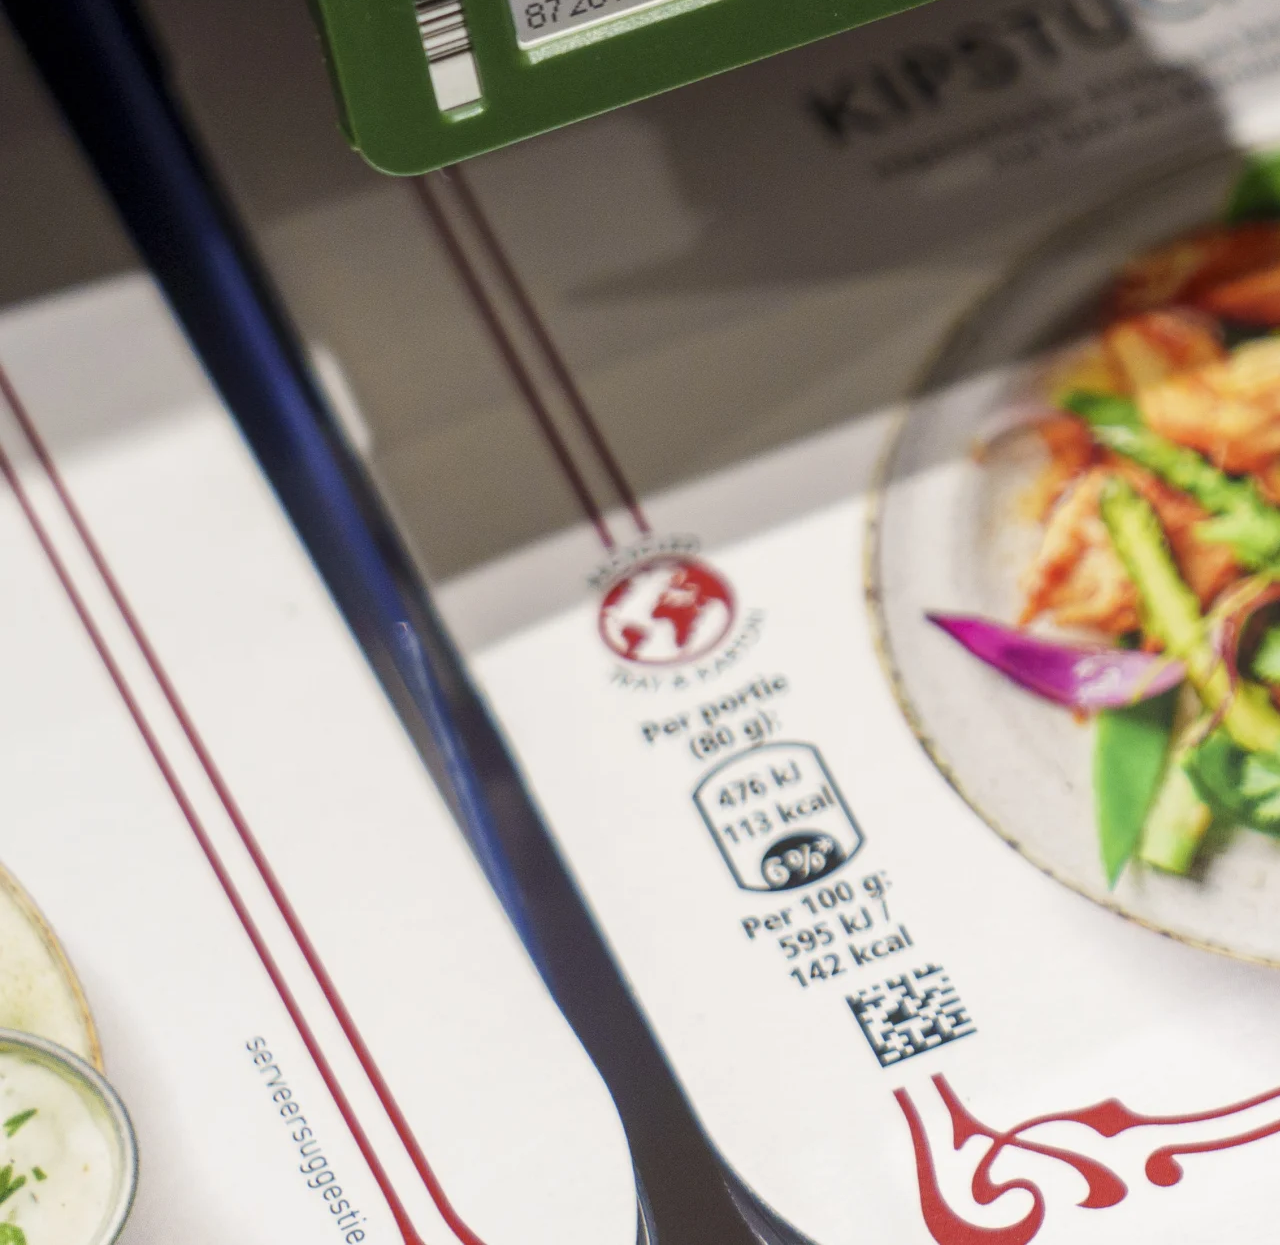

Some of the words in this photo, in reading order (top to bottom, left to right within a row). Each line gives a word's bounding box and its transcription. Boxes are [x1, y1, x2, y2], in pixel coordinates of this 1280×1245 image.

[641, 715, 690, 744] Per
[700, 676, 788, 727] portie
[718, 776, 767, 808] 476
[770, 760, 802, 788] kJ
[723, 810, 773, 845] 113
[776, 785, 835, 824] kcal
[741, 908, 793, 940] Per
[801, 881, 855, 915] 100
[778, 922, 835, 959] 595
[838, 906, 874, 935] kJ
[790, 952, 847, 988] 142
[848, 923, 914, 966] kcal
[246, 1035, 368, 1245] serveersuggestie
